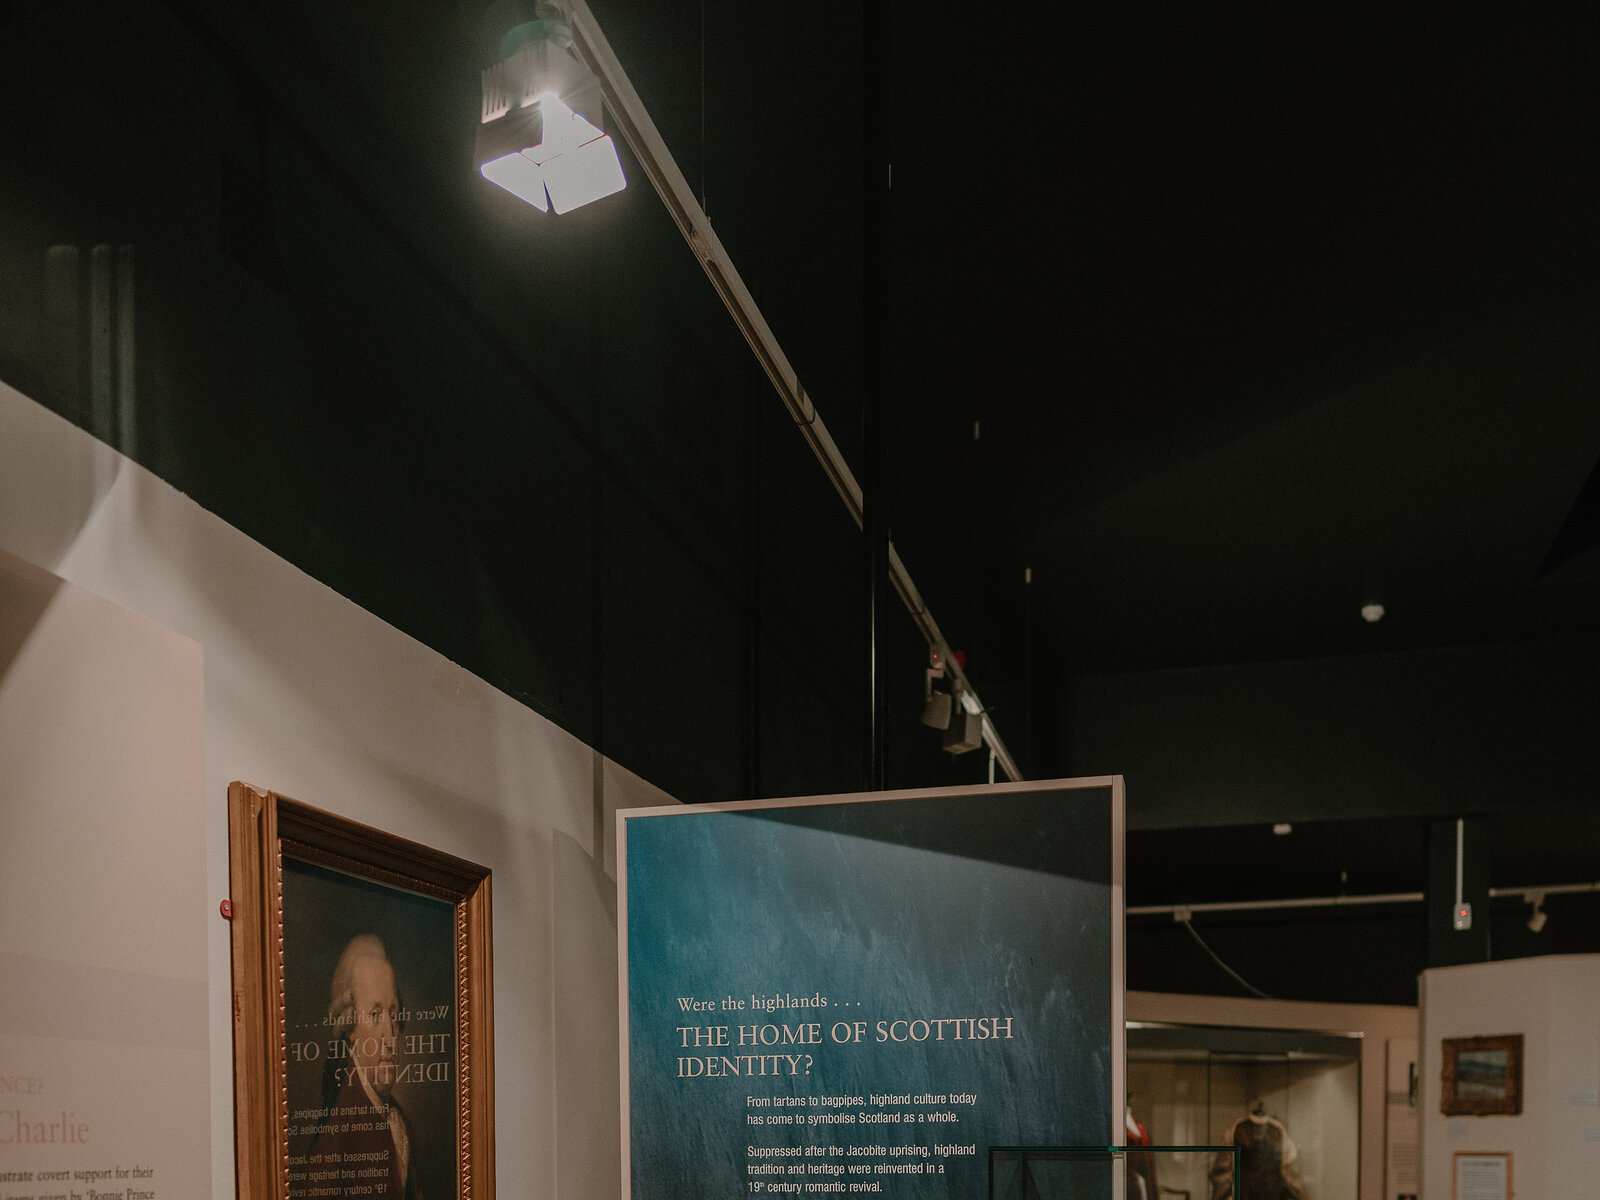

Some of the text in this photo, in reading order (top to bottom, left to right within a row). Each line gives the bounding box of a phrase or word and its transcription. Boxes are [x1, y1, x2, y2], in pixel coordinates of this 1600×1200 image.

[677, 992, 827, 1013] Were the highlands
[677, 1018, 1014, 1047] THE HOME OF SCOTTISH
[677, 1055, 813, 1078] IDENTITY?
[747, 1093, 977, 1108] From tartans to bagpipes, highland culture today
[747, 1115, 764, 1125] has
[767, 1115, 793, 1124] come
[795, 1115, 805, 1124] to
[808, 1113, 856, 1126] symbolise
[859, 1113, 900, 1123] Scotland
[903, 1114, 915, 1123] as
[927, 1112, 959, 1122] whole.
[747, 1144, 976, 1159] Suppressed after the Jacobite uprising, highland
[37, 1170, 70, 1181] covert
[74, 1169, 112, 1183] support
[116, 1165, 129, 1179] for
[133, 1165, 153, 1178] their
[747, 1163, 944, 1176] tradition and heritage were reinvented in a
[126, 1188, 155, 1200] Prince
[748, 1181, 882, 1194] 19th century romantic revival.
